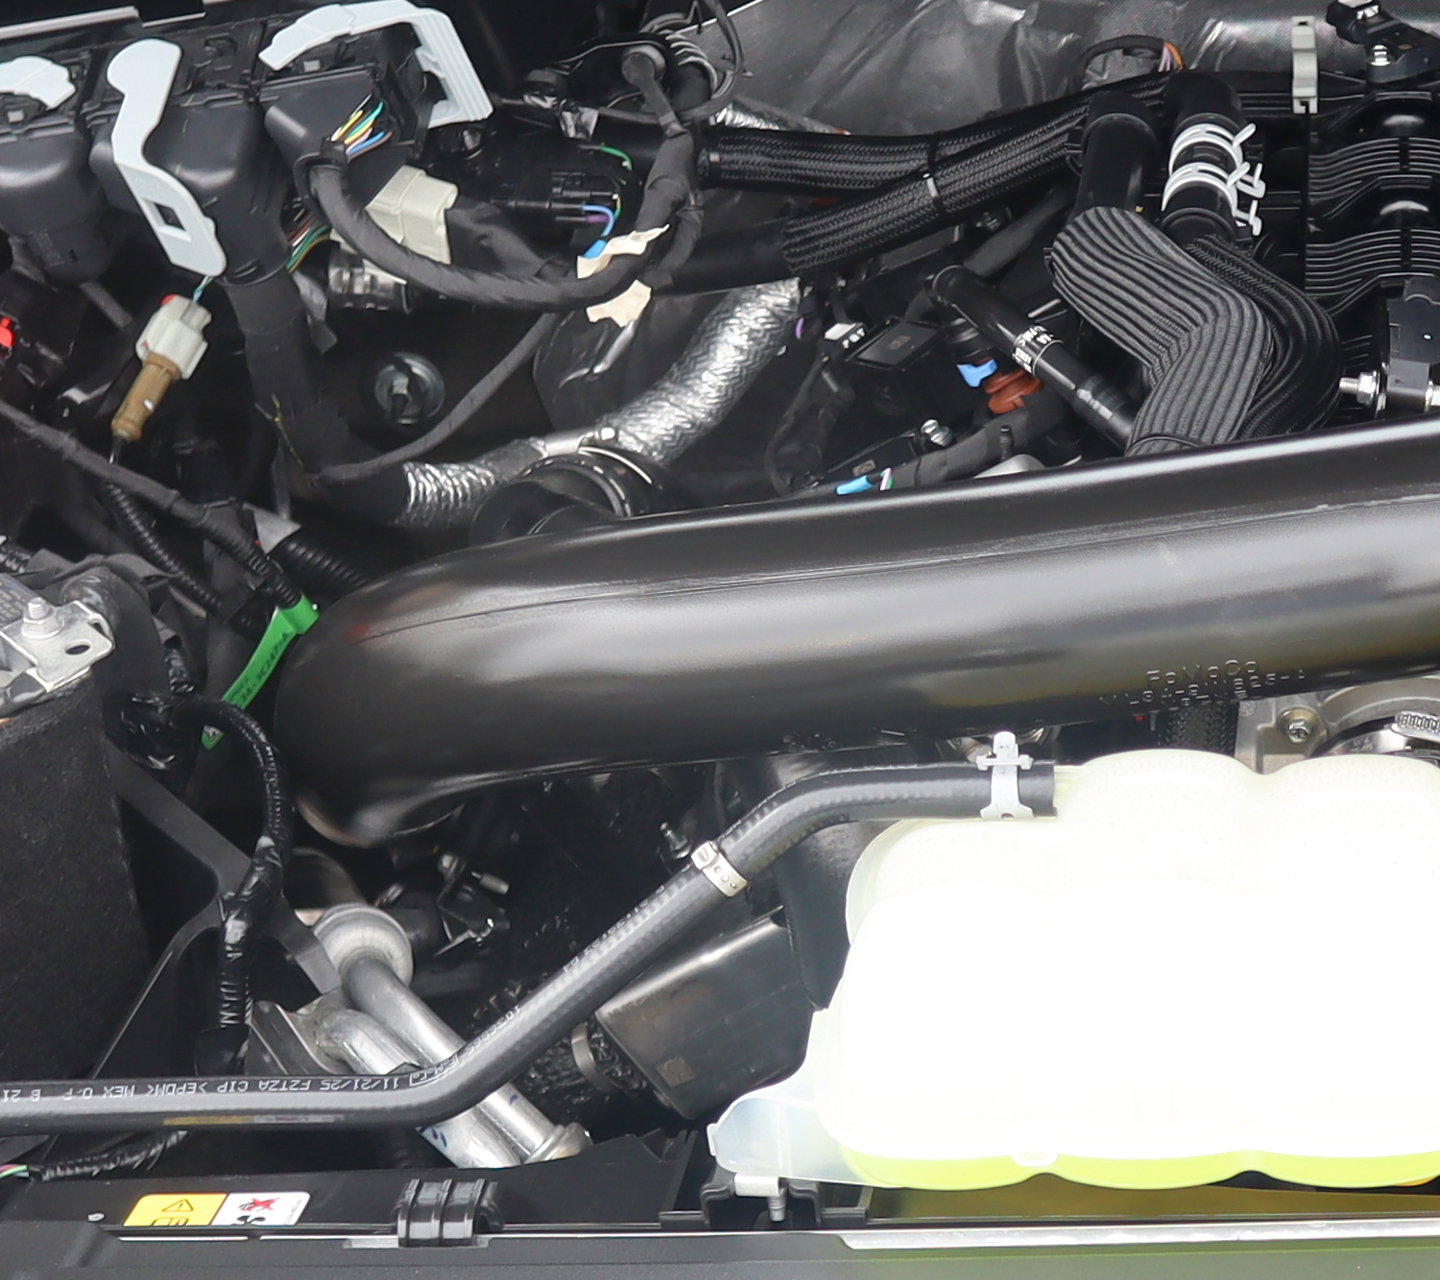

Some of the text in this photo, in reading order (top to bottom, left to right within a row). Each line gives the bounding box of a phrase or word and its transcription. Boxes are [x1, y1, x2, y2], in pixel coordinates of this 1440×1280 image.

[146, 1082, 208, 1097] >EPDM<
[217, 1080, 249, 1094] CIP
[320, 1077, 401, 1091] 11/21/25
[103, 1085, 136, 1098] MEX
